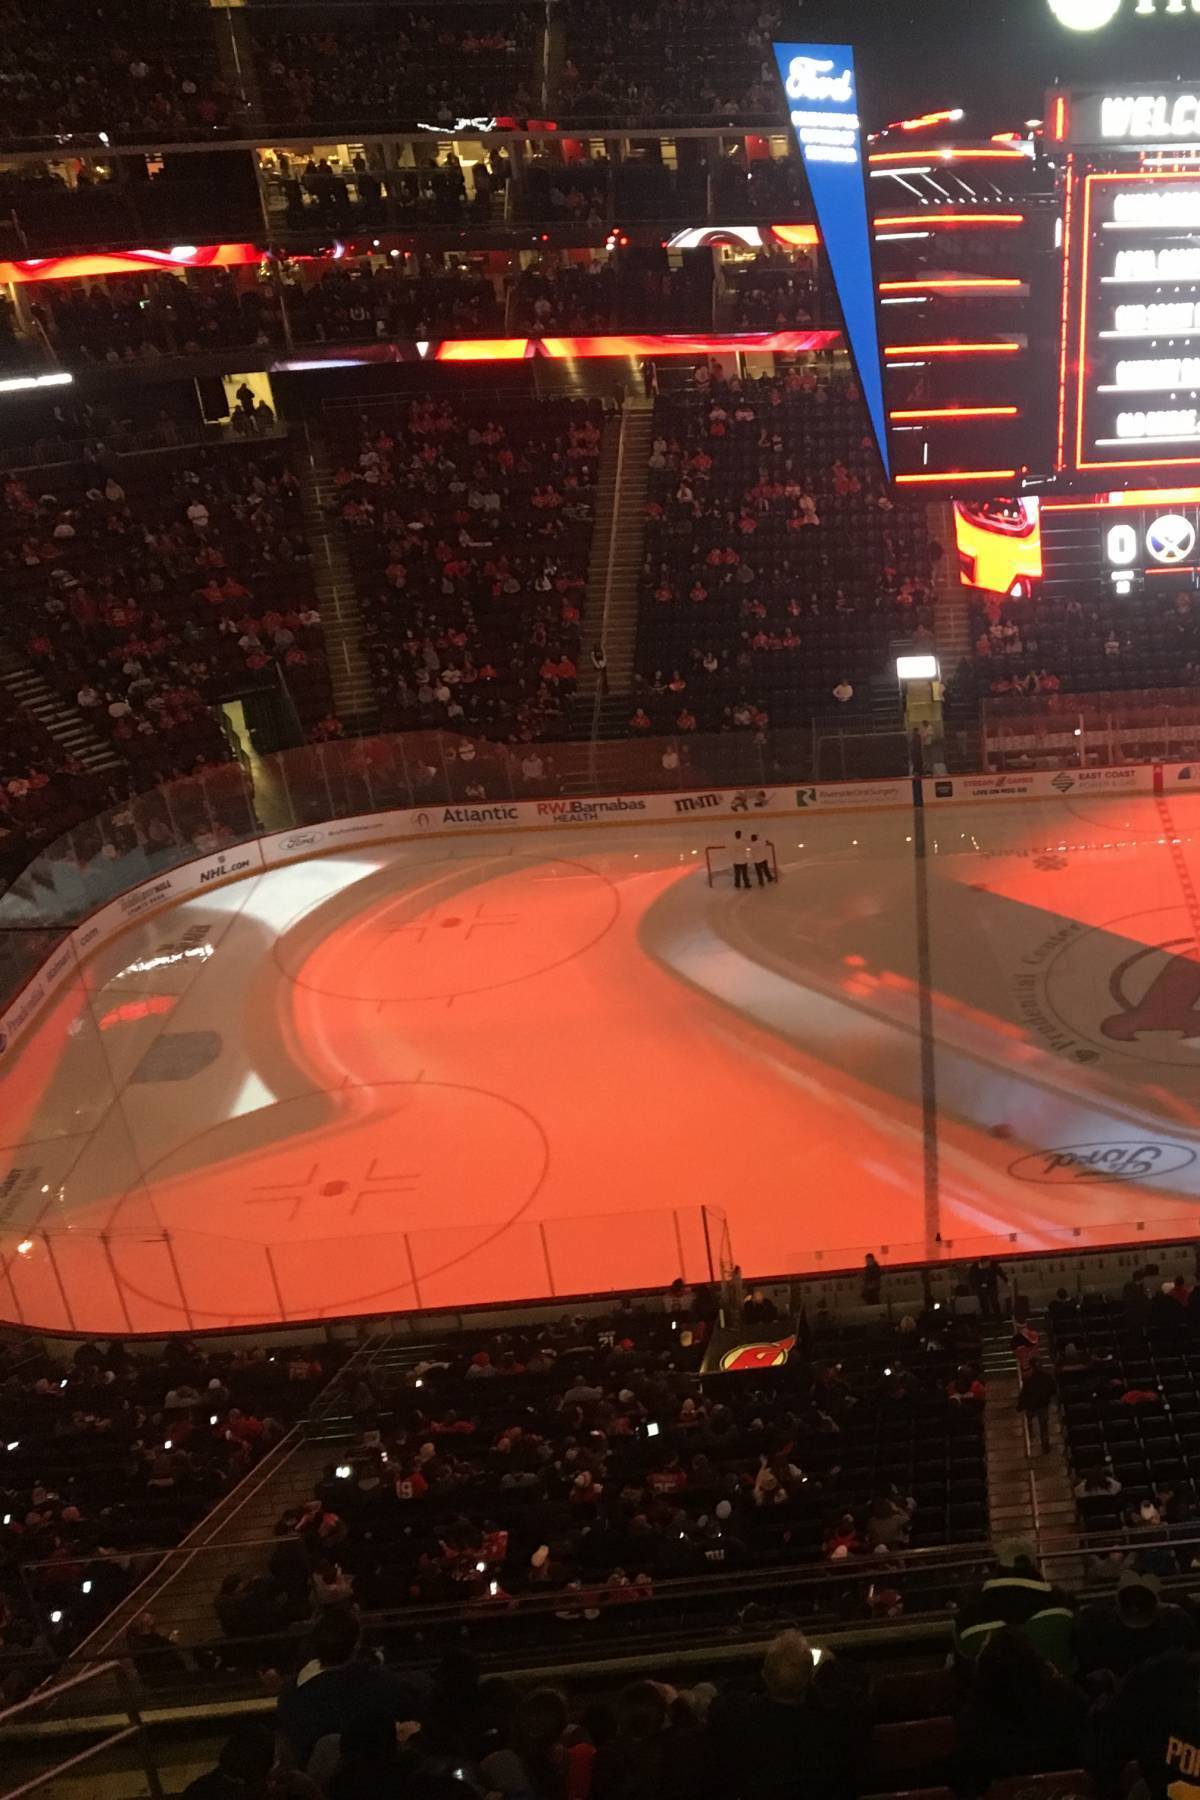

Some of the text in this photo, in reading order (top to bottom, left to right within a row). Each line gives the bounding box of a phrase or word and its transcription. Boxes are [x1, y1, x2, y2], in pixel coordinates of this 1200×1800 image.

[786, 56, 852, 101] Ford
[1107, 524, 1137, 565] 0
[1078, 769, 1136, 780] EAST COAST
[442, 807, 519, 823] Atlantic
[553, 812, 598, 823] HEALTH
[1012, 973, 1076, 1051] Prudential
[1042, 1146, 1163, 1178] Ford
